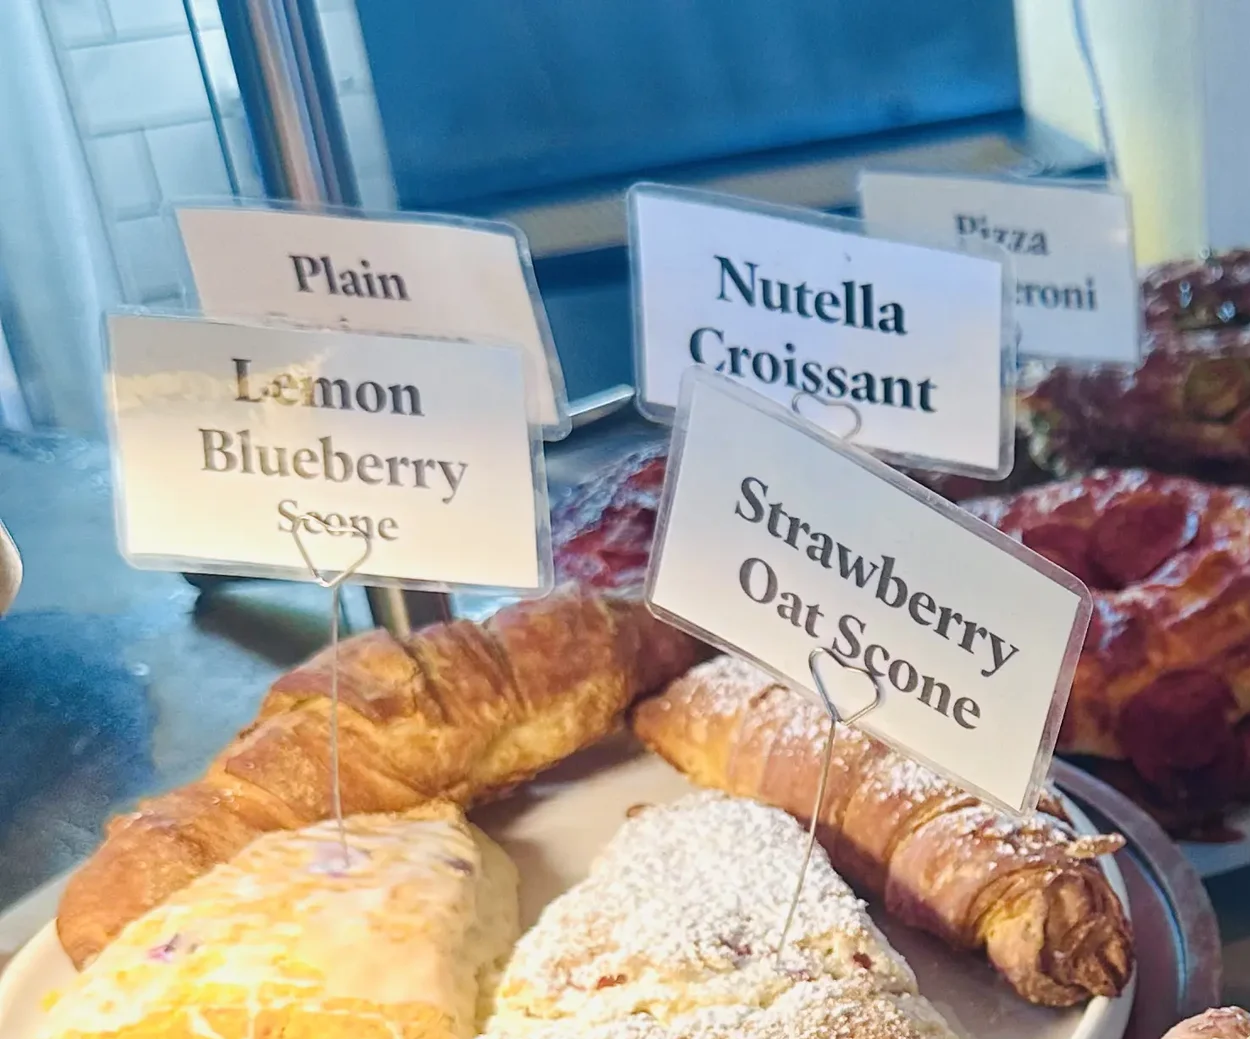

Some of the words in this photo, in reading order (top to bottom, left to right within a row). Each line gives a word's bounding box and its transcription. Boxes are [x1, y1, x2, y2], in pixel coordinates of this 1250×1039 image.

[288, 254, 412, 302] Plain
[713, 254, 908, 336] Nutella
[231, 357, 426, 418] Lemon
[689, 326, 938, 413] Croissant
[198, 426, 470, 505] Blueberry
[277, 499, 400, 541] Scone
[734, 475, 1020, 678] Strawberry
[738, 557, 825, 638] Oat
[831, 613, 981, 730] Scone
